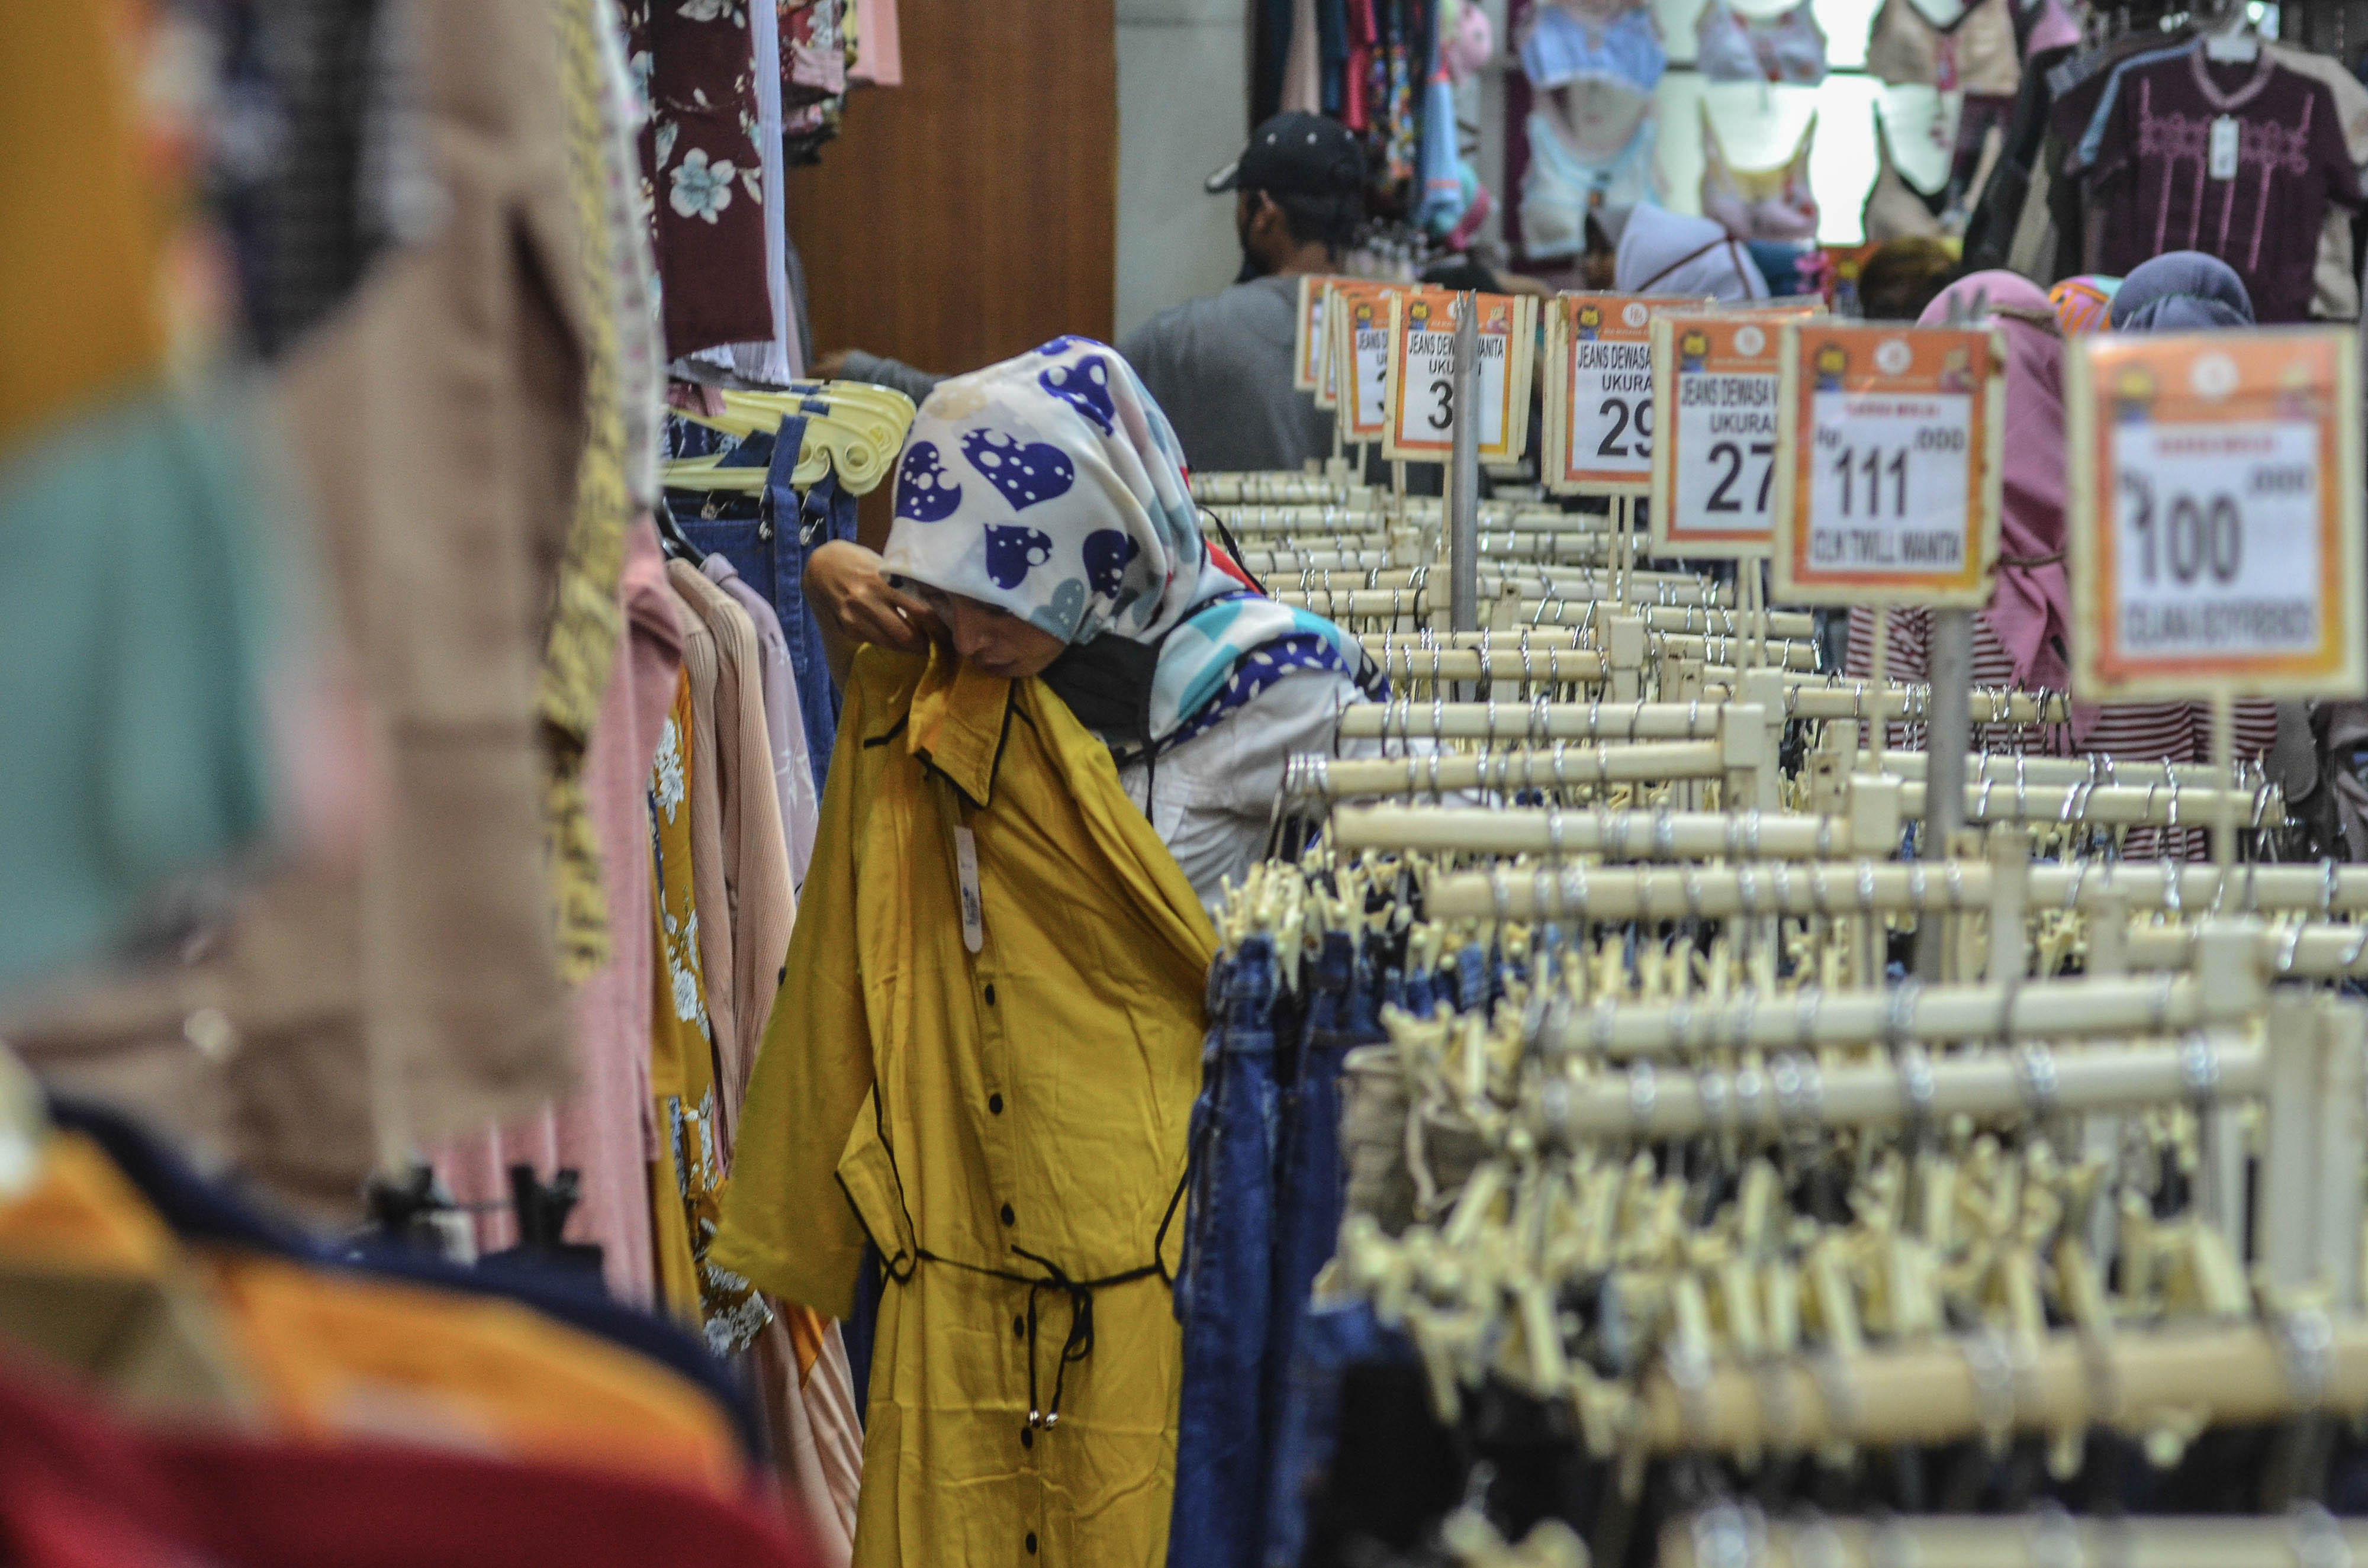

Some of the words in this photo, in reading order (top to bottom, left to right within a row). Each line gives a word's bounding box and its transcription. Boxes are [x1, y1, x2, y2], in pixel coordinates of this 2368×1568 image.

[1408, 333, 1436, 355] JEANS
[1478, 336, 1504, 358] ANITA
[1578, 344, 1609, 370] JEANS
[1611, 344, 1651, 370] DEWASA
[1602, 374, 1653, 392] UKURA
[1682, 377, 1717, 406] JEANS
[1722, 377, 1769, 407] DEWASA
[1428, 381, 1453, 430] 3
[1710, 413, 1778, 434] UKURA
[1597, 398, 1654, 459] 29
[1706, 441, 1777, 514] 27
[1835, 446, 1910, 519] 111
[2134, 485, 2241, 586] 100
